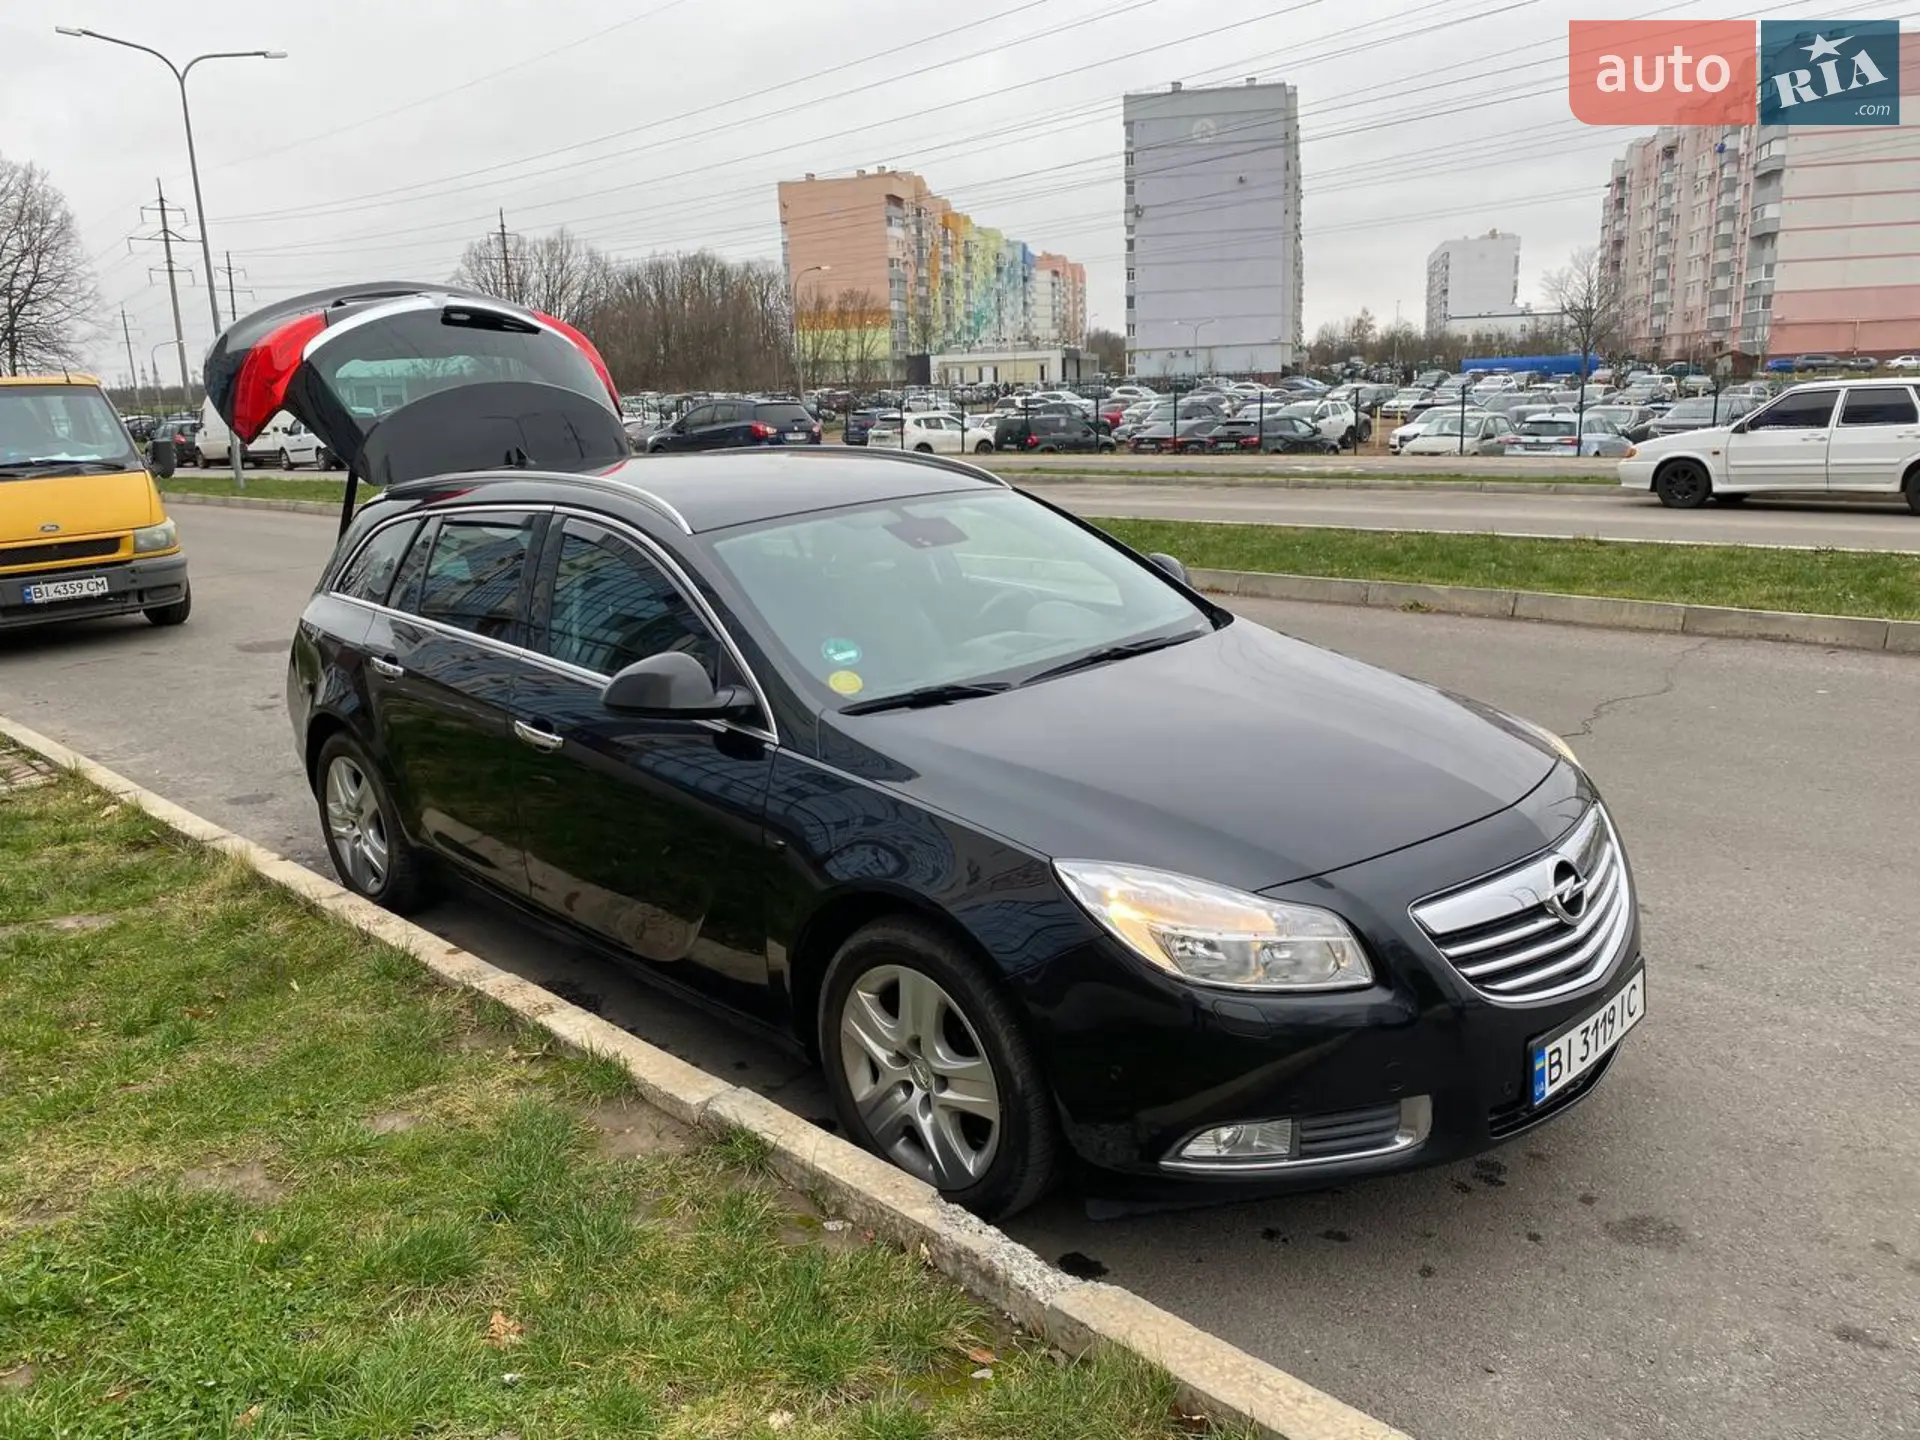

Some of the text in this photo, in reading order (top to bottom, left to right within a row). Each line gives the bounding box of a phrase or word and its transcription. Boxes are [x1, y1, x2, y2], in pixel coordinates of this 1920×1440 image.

[33, 580, 107, 598] BI 4359 CM
[1548, 983, 1637, 1085] BI 3119 IC
